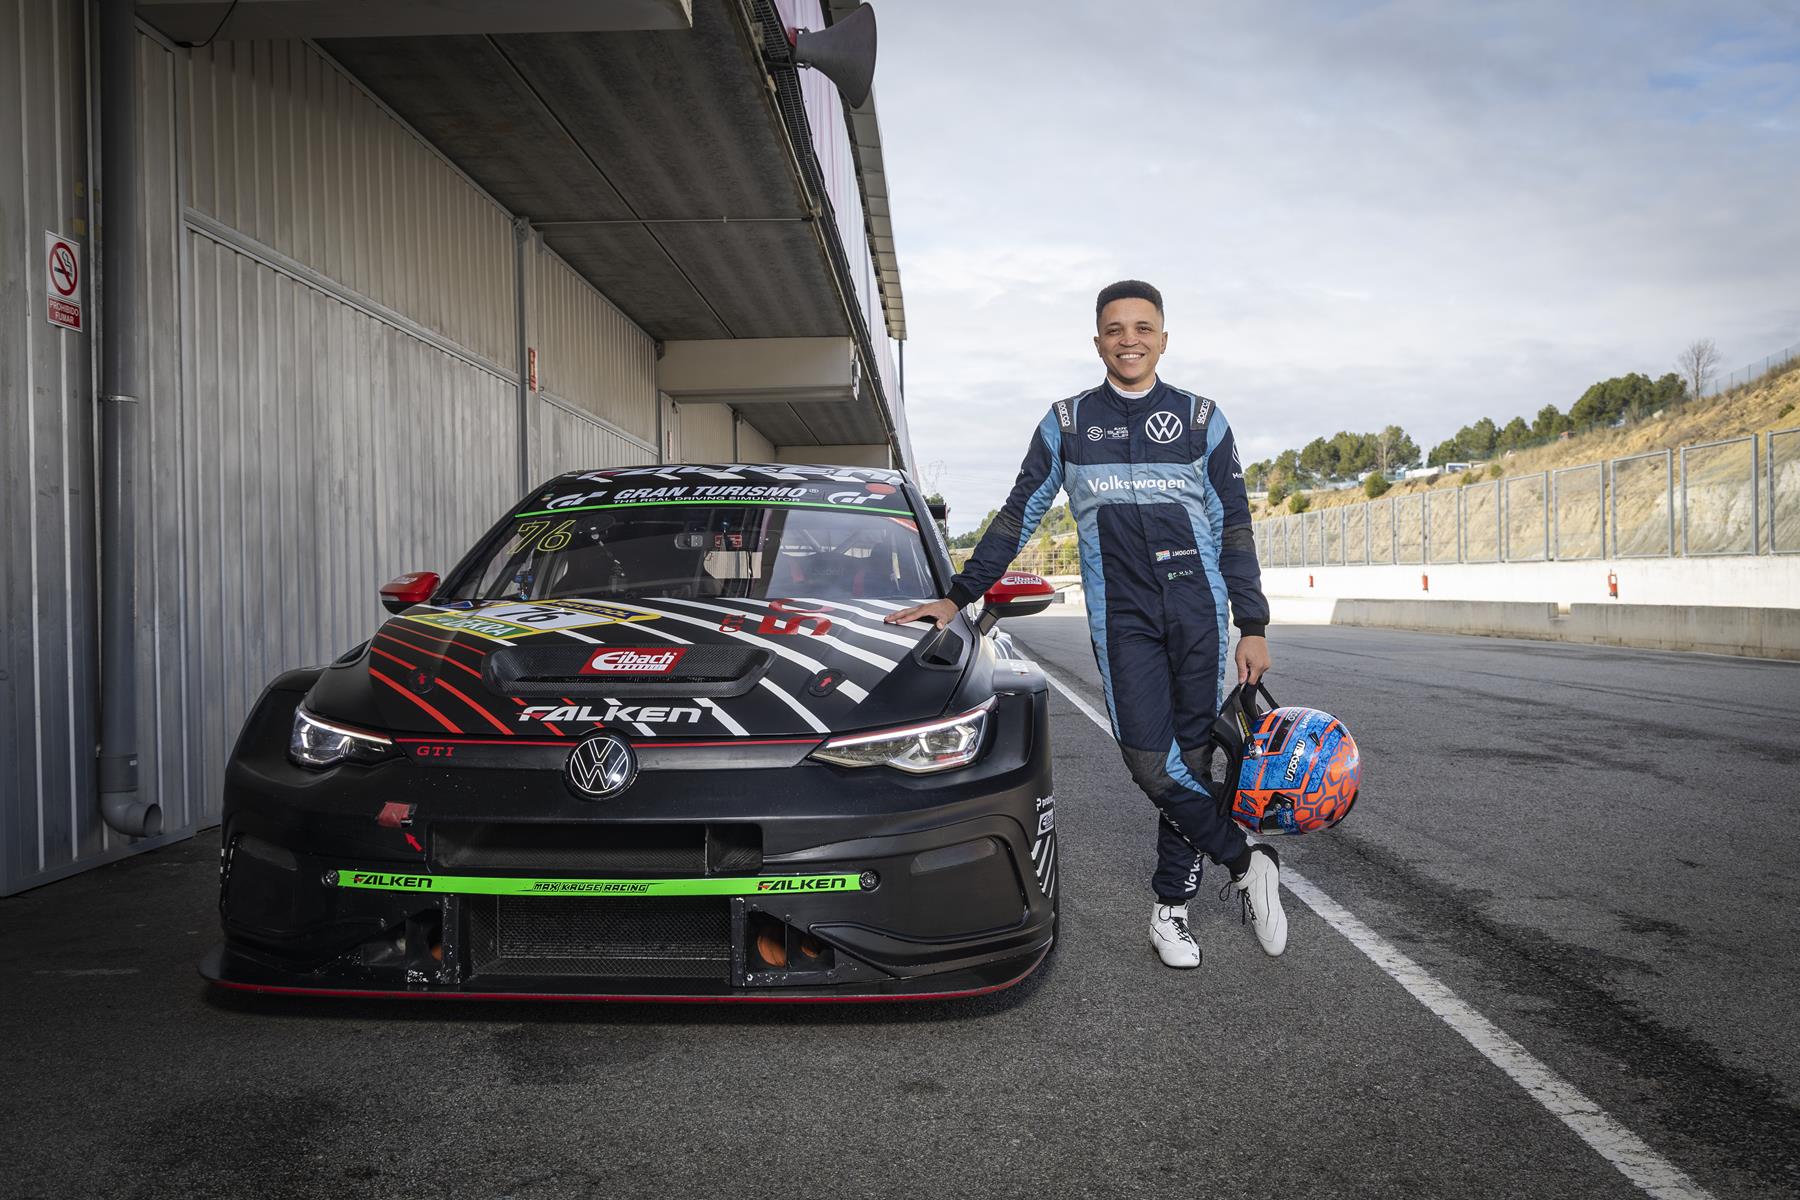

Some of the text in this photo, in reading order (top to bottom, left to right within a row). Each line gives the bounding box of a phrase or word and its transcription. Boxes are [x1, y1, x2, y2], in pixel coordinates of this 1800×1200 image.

[49, 301, 79, 316] PROHIBIDO
[55, 312, 75, 324] FUMAR
[1088, 475, 1186, 493] Volkswagen
[613, 487, 690, 500] GRAN
[729, 495, 800, 503] SIMULATOR
[507, 519, 577, 555] 76
[1001, 576, 1042, 586] Eibach
[495, 606, 577, 623] 76
[592, 651, 678, 671] Eibach
[515, 706, 702, 723] FALKEN
[416, 745, 456, 757] GTI
[353, 874, 433, 888] FALKEN
[533, 882, 559, 892] MAX
[603, 883, 649, 893] RACING
[757, 878, 847, 891] FALKEN
